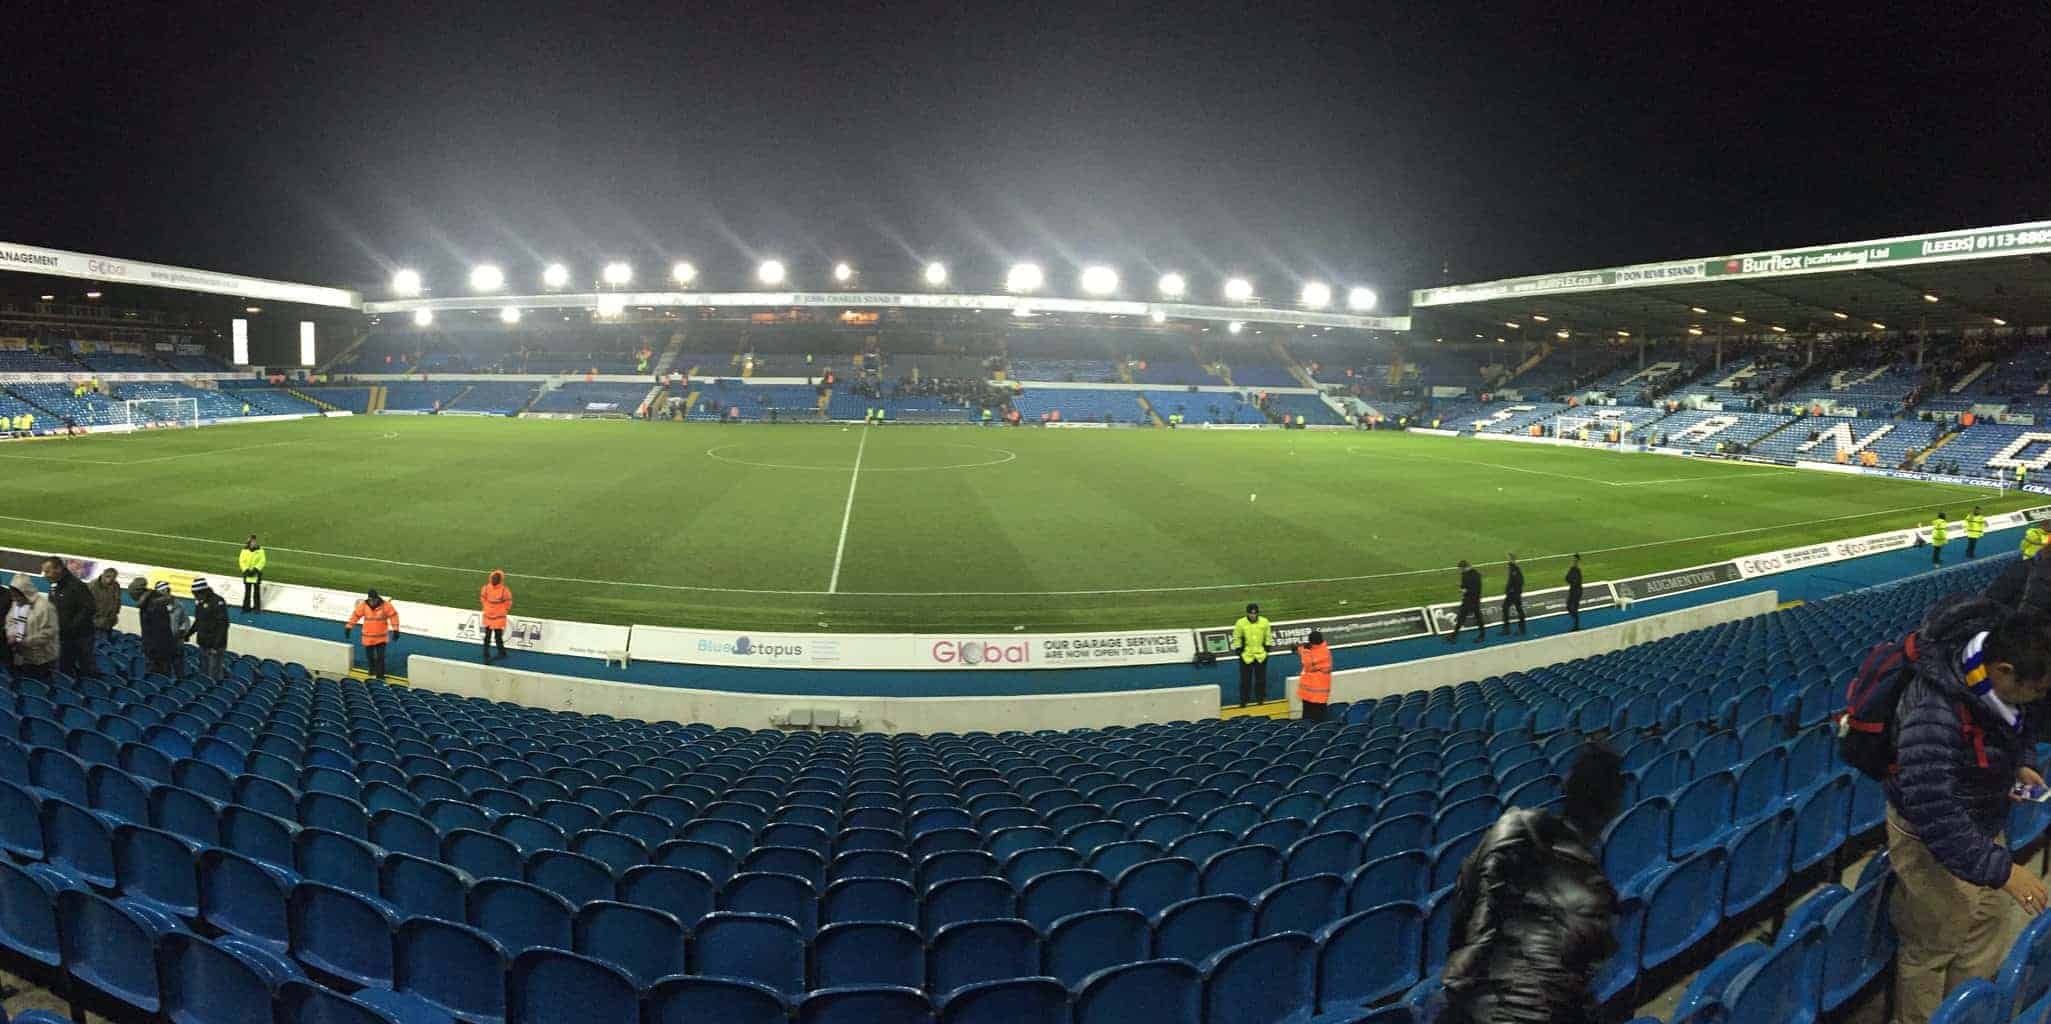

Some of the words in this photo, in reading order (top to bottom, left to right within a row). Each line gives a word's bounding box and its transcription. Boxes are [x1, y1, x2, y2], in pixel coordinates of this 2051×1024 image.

[1742, 255, 1803, 273] Burflex
[1043, 639, 1069, 650] OUR
[1072, 638, 1122, 649] GARAGE
[1126, 635, 1179, 648] SERVICES
[932, 640, 1030, 664] Global
[1044, 650, 1065, 659] ARE
[1066, 649, 1091, 658] NOW
[1095, 648, 1121, 657] OPEN
[1122, 647, 1136, 656] TO
[1138, 646, 1154, 655] ALL
